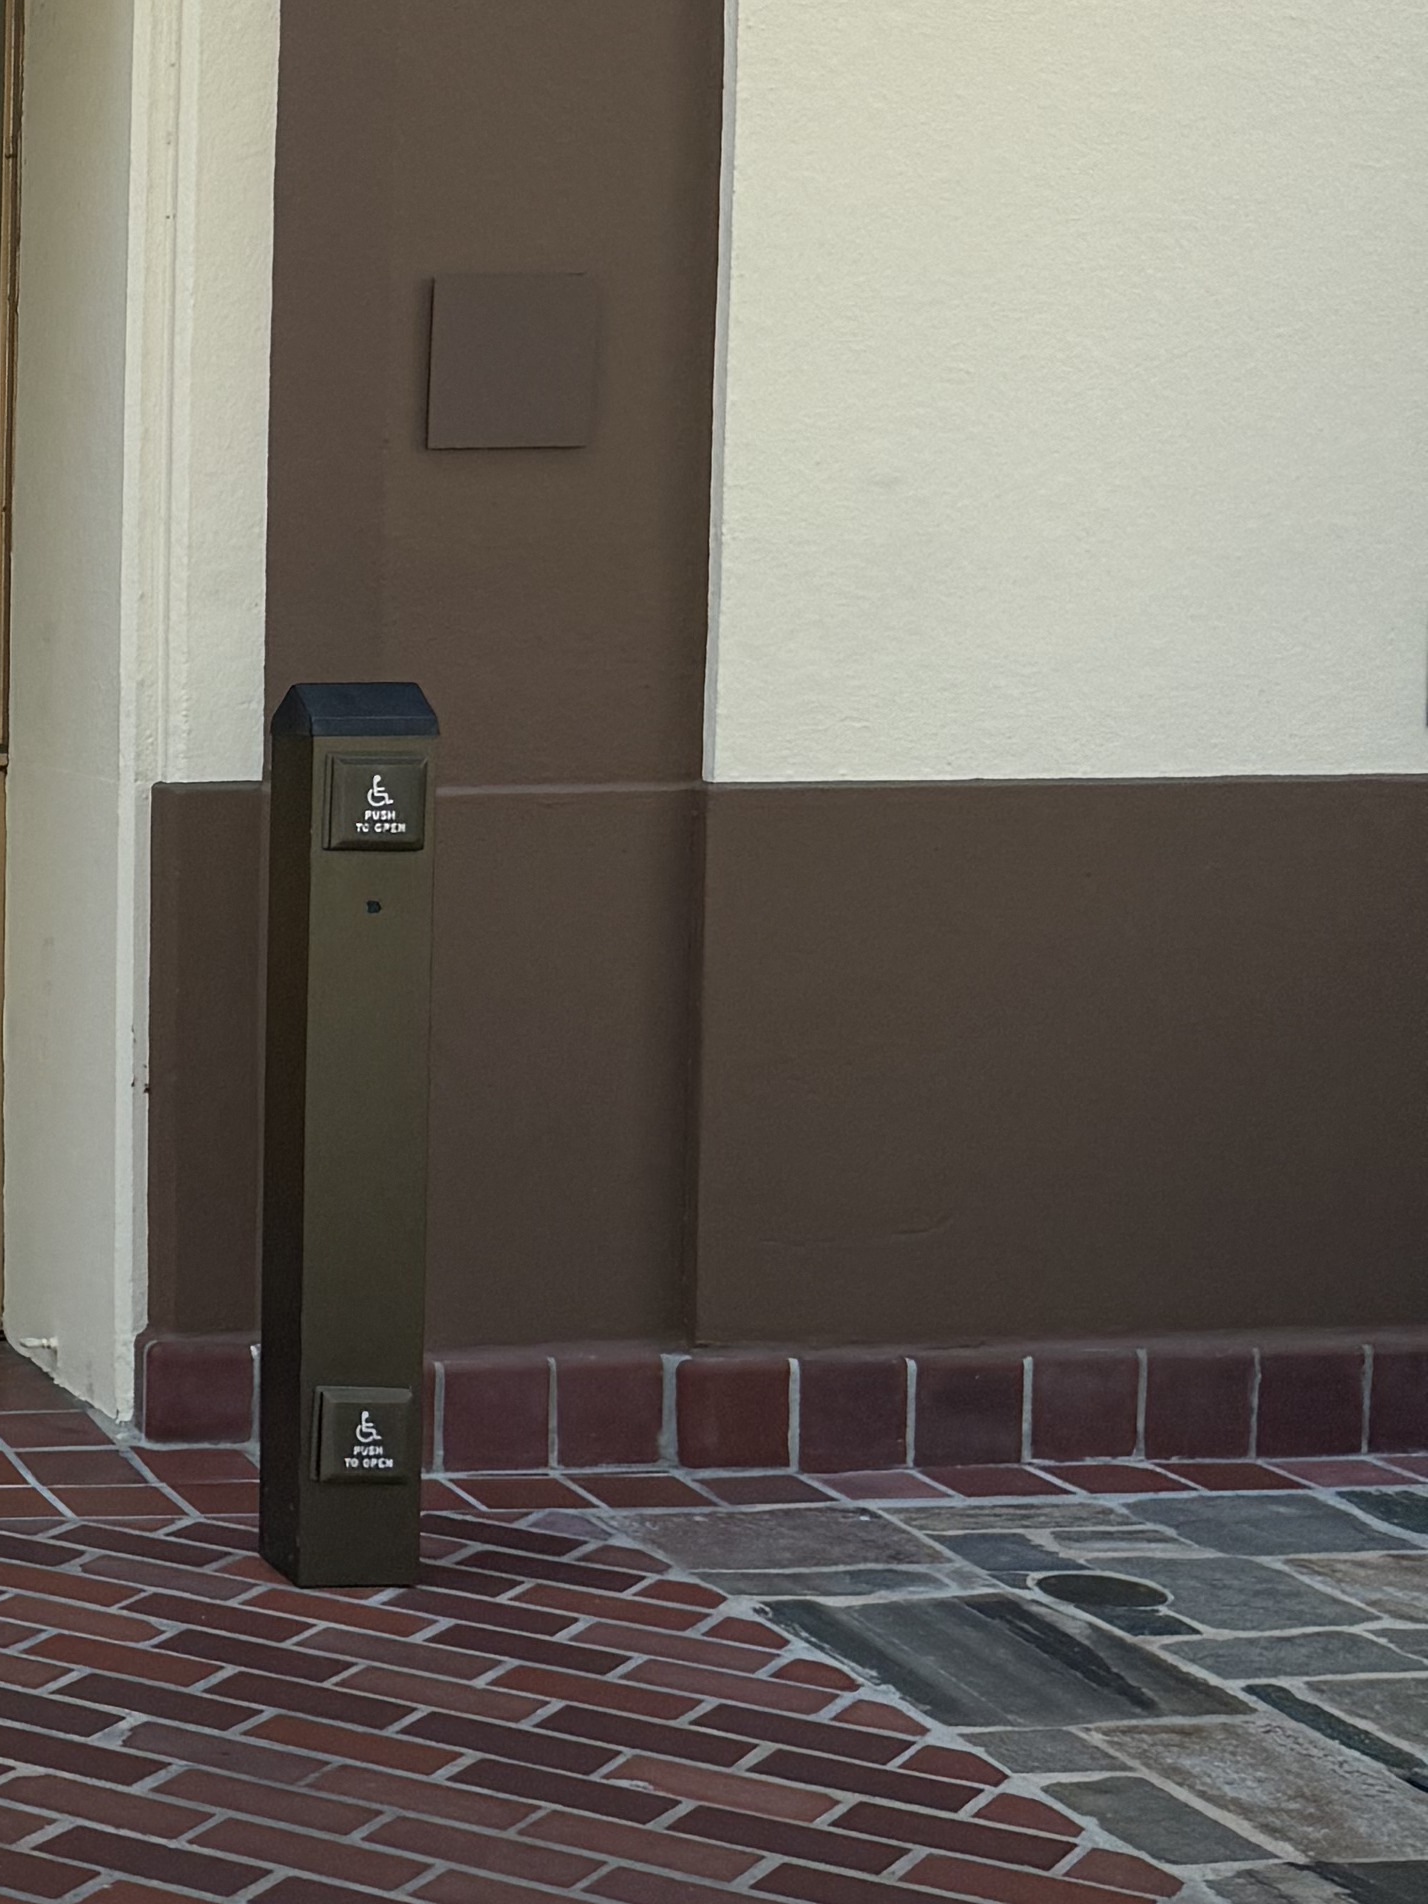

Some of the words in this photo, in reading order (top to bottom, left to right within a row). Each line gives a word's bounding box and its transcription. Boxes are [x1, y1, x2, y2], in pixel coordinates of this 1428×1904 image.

[364, 810, 396, 821] PUSH
[355, 822, 370, 833] TO
[374, 822, 406, 834] OPEN
[353, 1445, 384, 1456] PUSH
[344, 1457, 359, 1468] TO
[362, 1457, 394, 1469] OPEN
